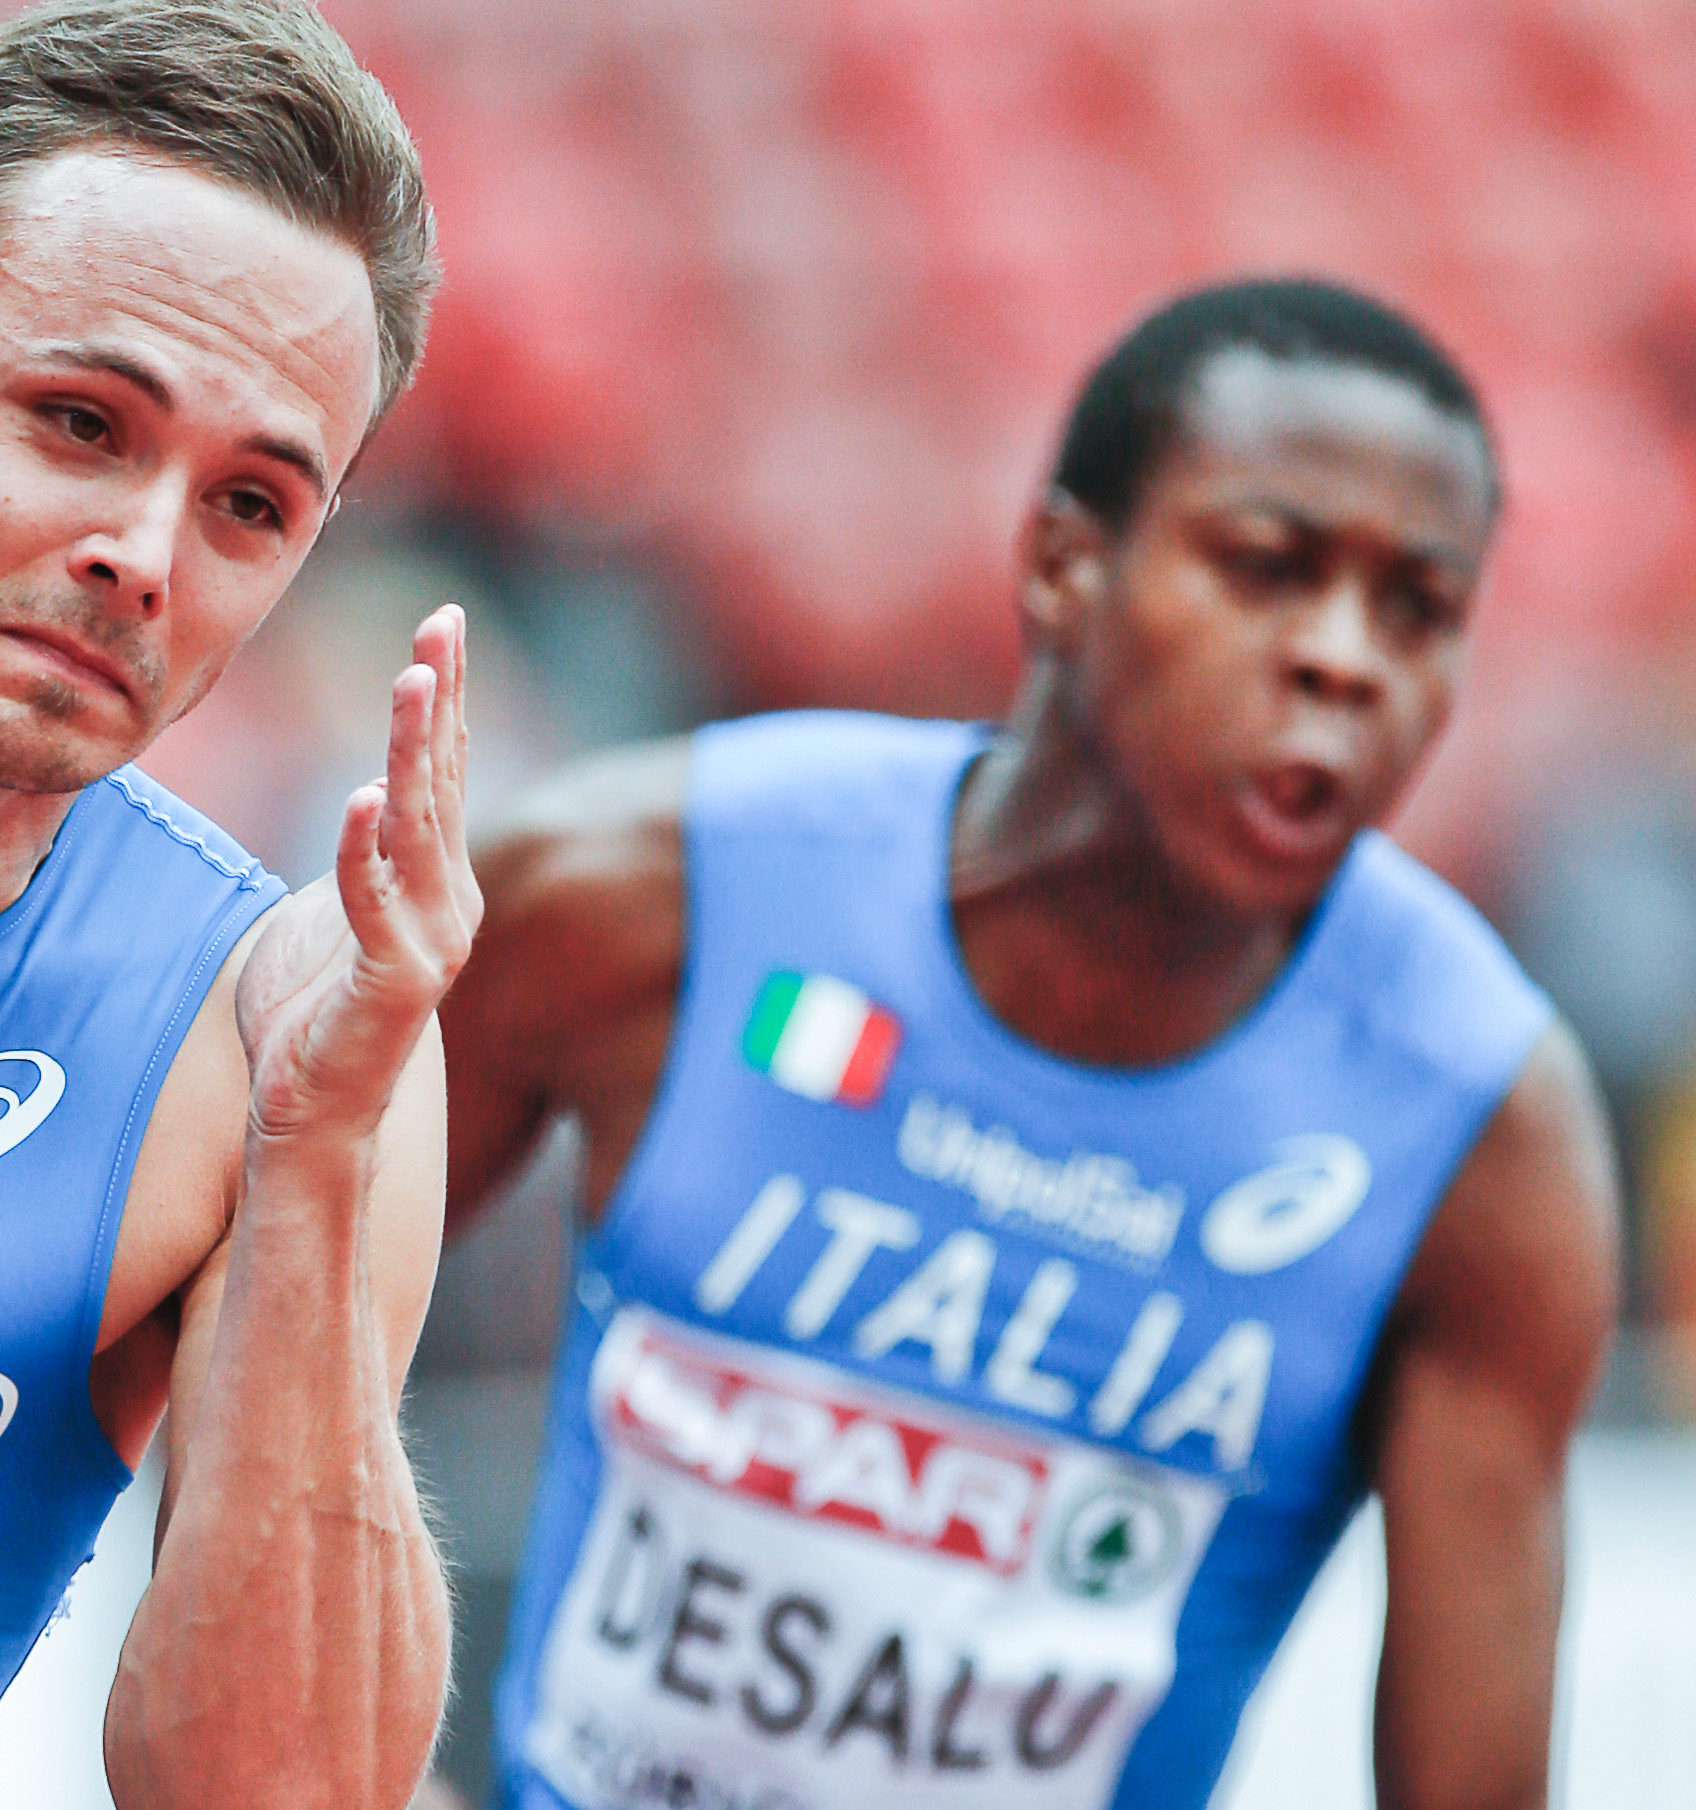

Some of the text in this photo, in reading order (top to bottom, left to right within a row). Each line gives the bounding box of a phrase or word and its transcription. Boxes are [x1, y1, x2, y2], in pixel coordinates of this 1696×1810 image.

[622, 1350, 1039, 1562] SPAR
[695, 1173, 1274, 1472] ITALIA
[596, 1503, 1118, 1774] DESALU
